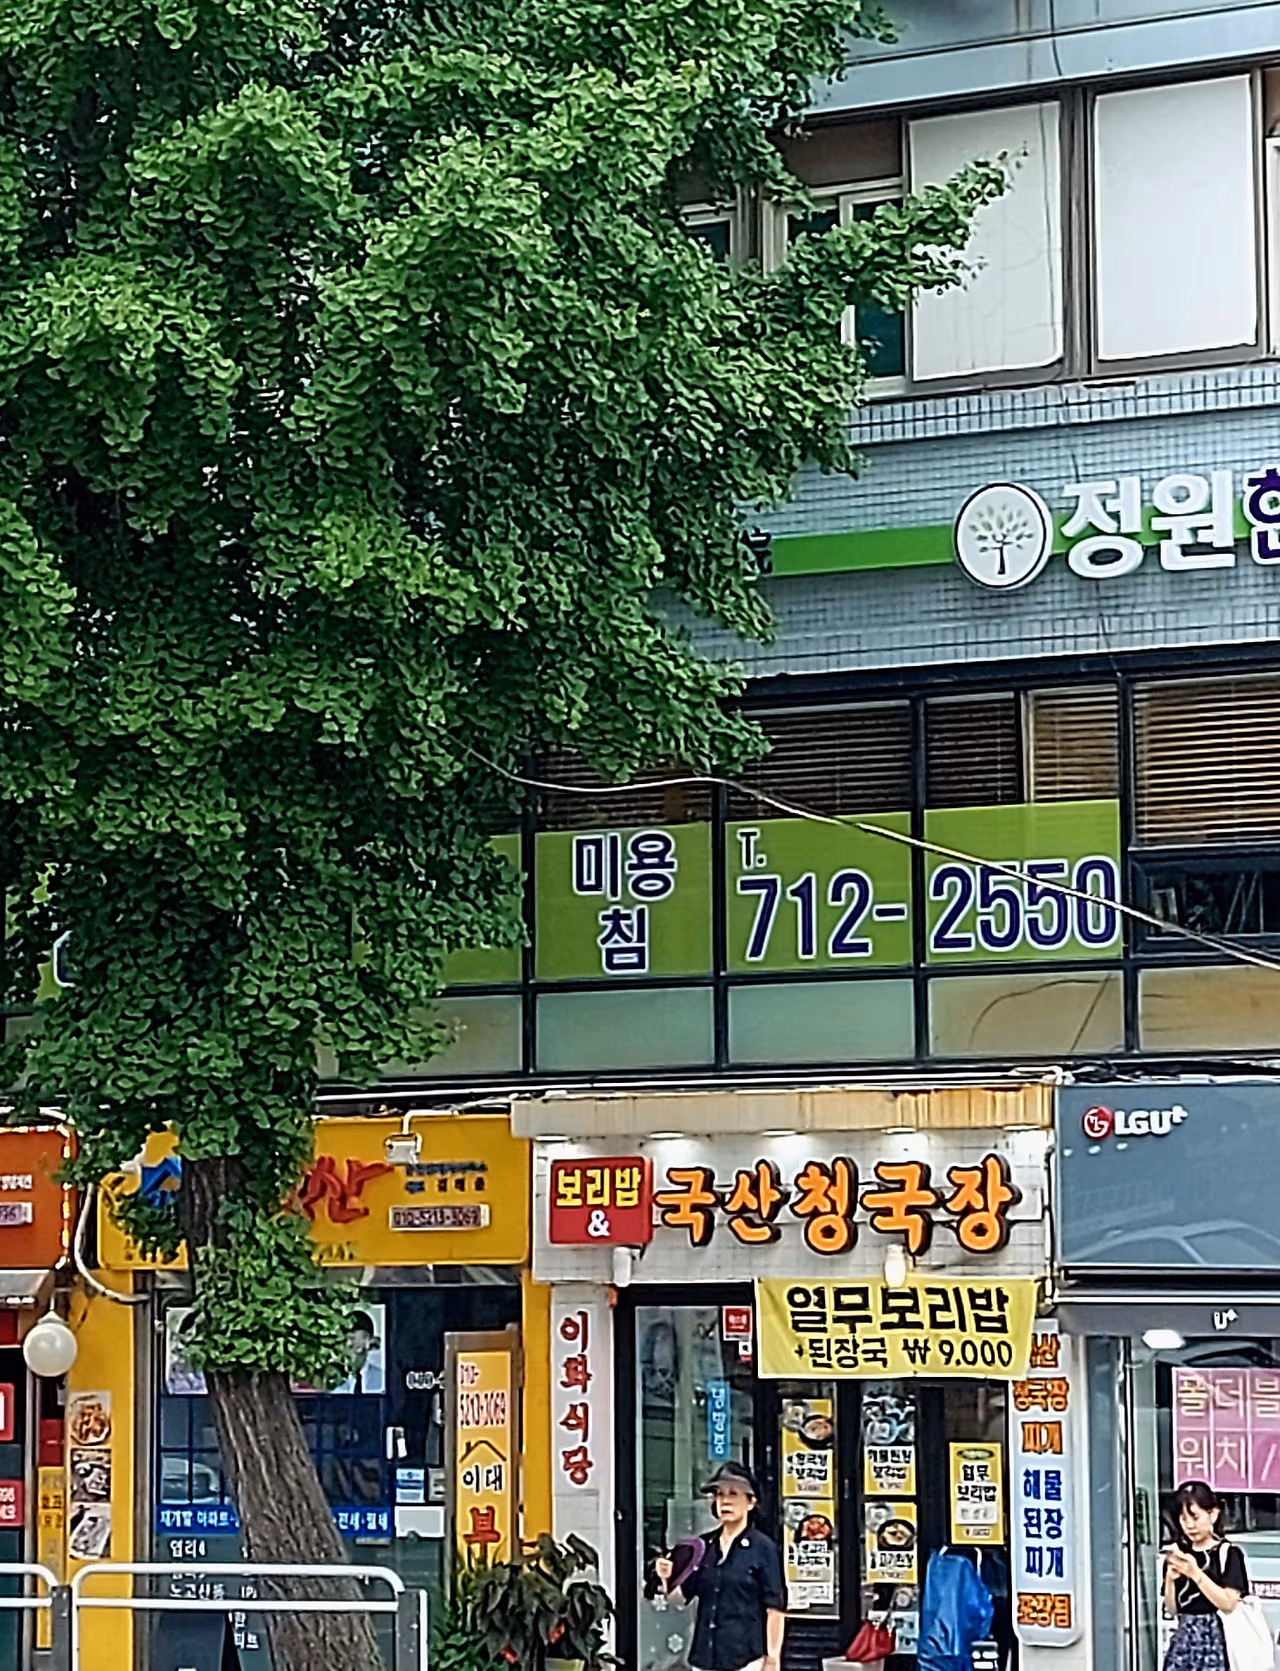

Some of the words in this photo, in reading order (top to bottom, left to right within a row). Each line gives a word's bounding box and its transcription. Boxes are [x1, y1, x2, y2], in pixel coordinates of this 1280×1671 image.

[570, 831, 678, 900] 미용
[738, 828, 766, 870] T.
[596, 905, 650, 975] 침
[555, 1167, 642, 1208] 보리밥
[587, 1210, 611, 1238] &
[786, 1286, 1010, 1334] 열무보리밥
[462, 1464, 504, 1493] 이대
[1023, 1468, 1063, 1501] 해물
[1023, 1507, 1064, 1540] 된장
